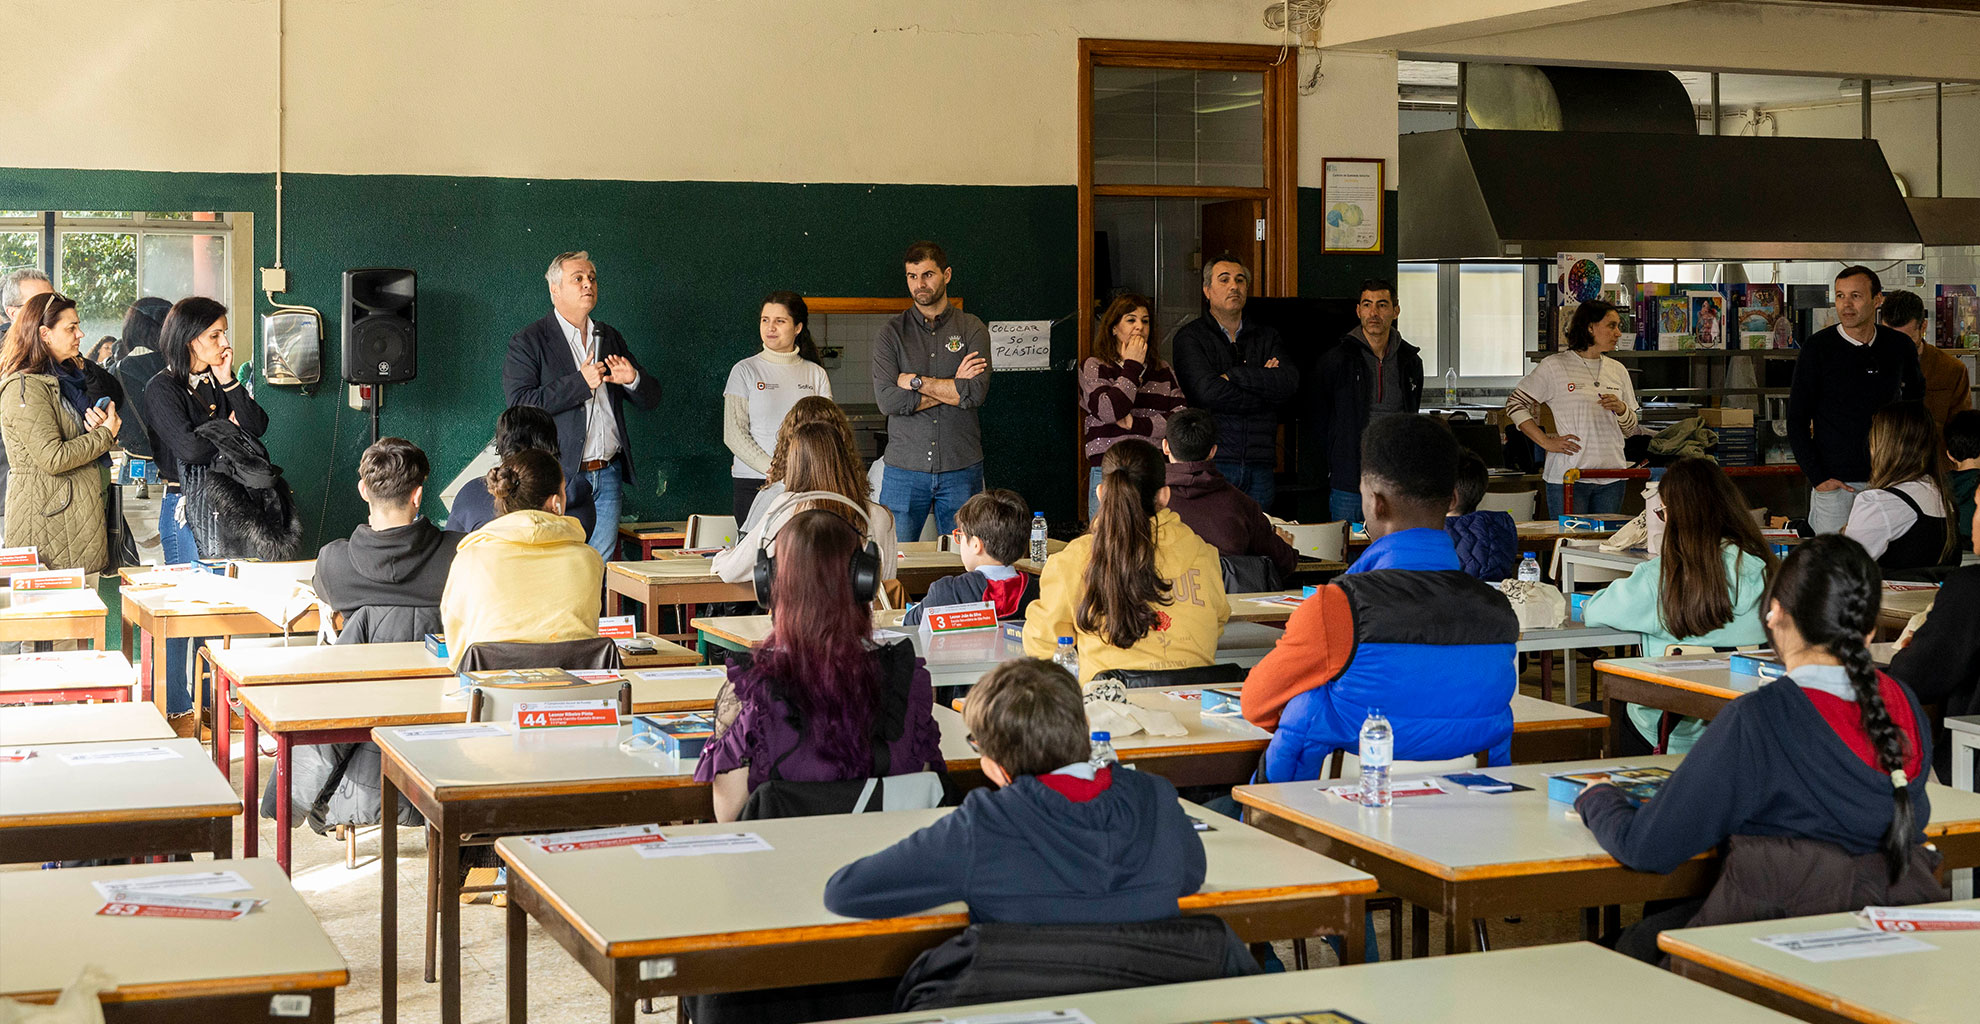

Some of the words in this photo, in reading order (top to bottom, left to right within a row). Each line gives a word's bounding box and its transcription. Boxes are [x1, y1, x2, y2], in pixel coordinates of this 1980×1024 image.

[991, 324, 1040, 333] COLOCAR
[15, 579, 32, 590] 21
[936, 616, 946, 628] 3
[523, 712, 547, 726] 44
[104, 903, 140, 916] 53
